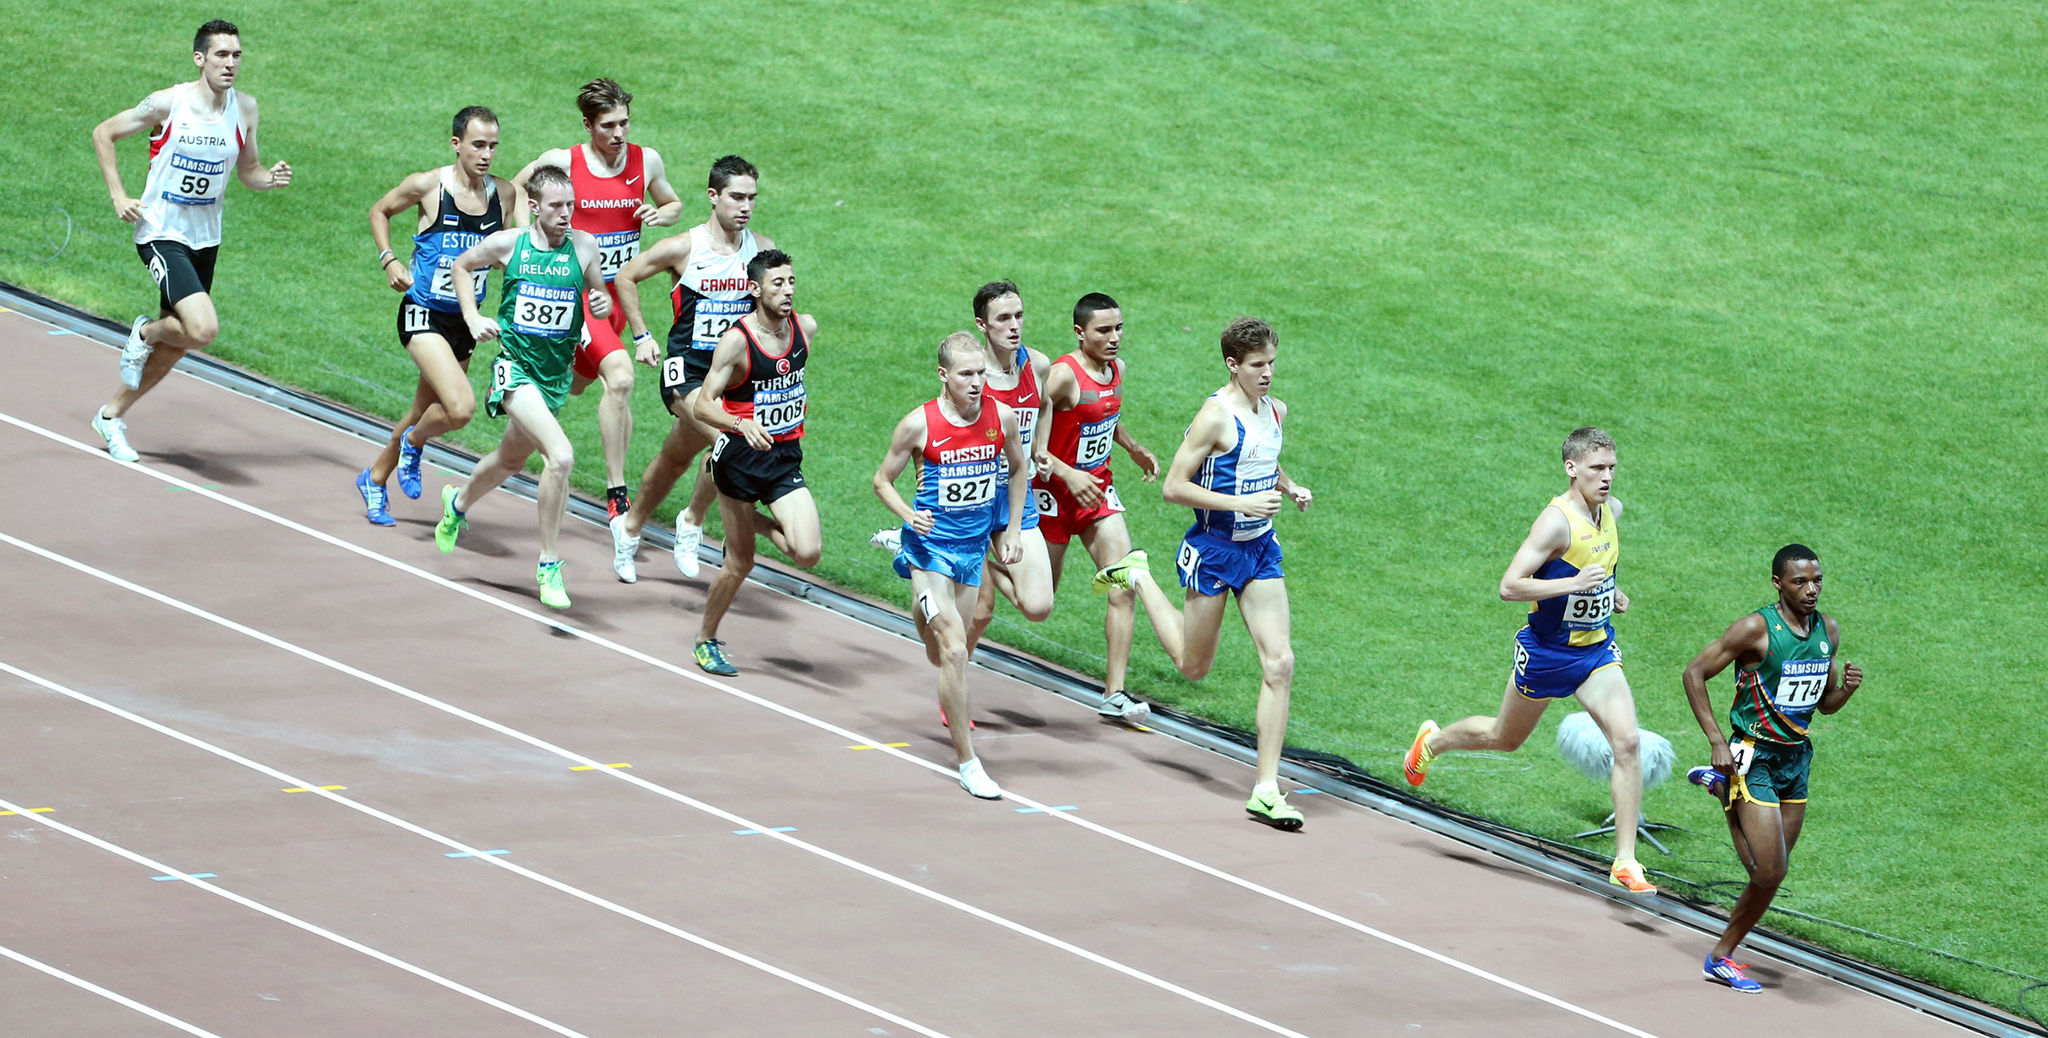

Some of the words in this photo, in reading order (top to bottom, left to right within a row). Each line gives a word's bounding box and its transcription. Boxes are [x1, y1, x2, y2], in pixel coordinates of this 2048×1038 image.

[178, 135, 227, 147] AUSTRIA
[172, 155, 224, 174] SAMSUNG
[180, 174, 210, 195] 59
[580, 199, 635, 209] DANMARK
[442, 232, 485, 249] ESTON
[596, 232, 640, 246] AMSUNG
[519, 264, 571, 277] IRELAND
[440, 272, 481, 293] 21
[520, 284, 575, 301] SAMSUNG
[407, 308, 428, 328] 11
[521, 301, 568, 326] 387
[697, 302, 752, 314] SAMSUNG
[700, 318, 731, 338] 12
[498, 365, 506, 386] 8
[669, 361, 678, 382] 6
[755, 384, 806, 404] SAMSUNG
[756, 399, 803, 427] 1008
[940, 444, 996, 465] RUSSIA
[940, 461, 998, 477] SAMSUNG
[946, 477, 991, 503] 827
[1242, 475, 1278, 492] SAMSU
[1039, 491, 1053, 511] 3
[1182, 546, 1191, 567] 9
[919, 594, 930, 617] 7
[1572, 595, 1611, 619] 959
[1783, 662, 1831, 675] SAMSUNG
[1788, 679, 1822, 702] 774
[1733, 748, 1744, 770] 4
